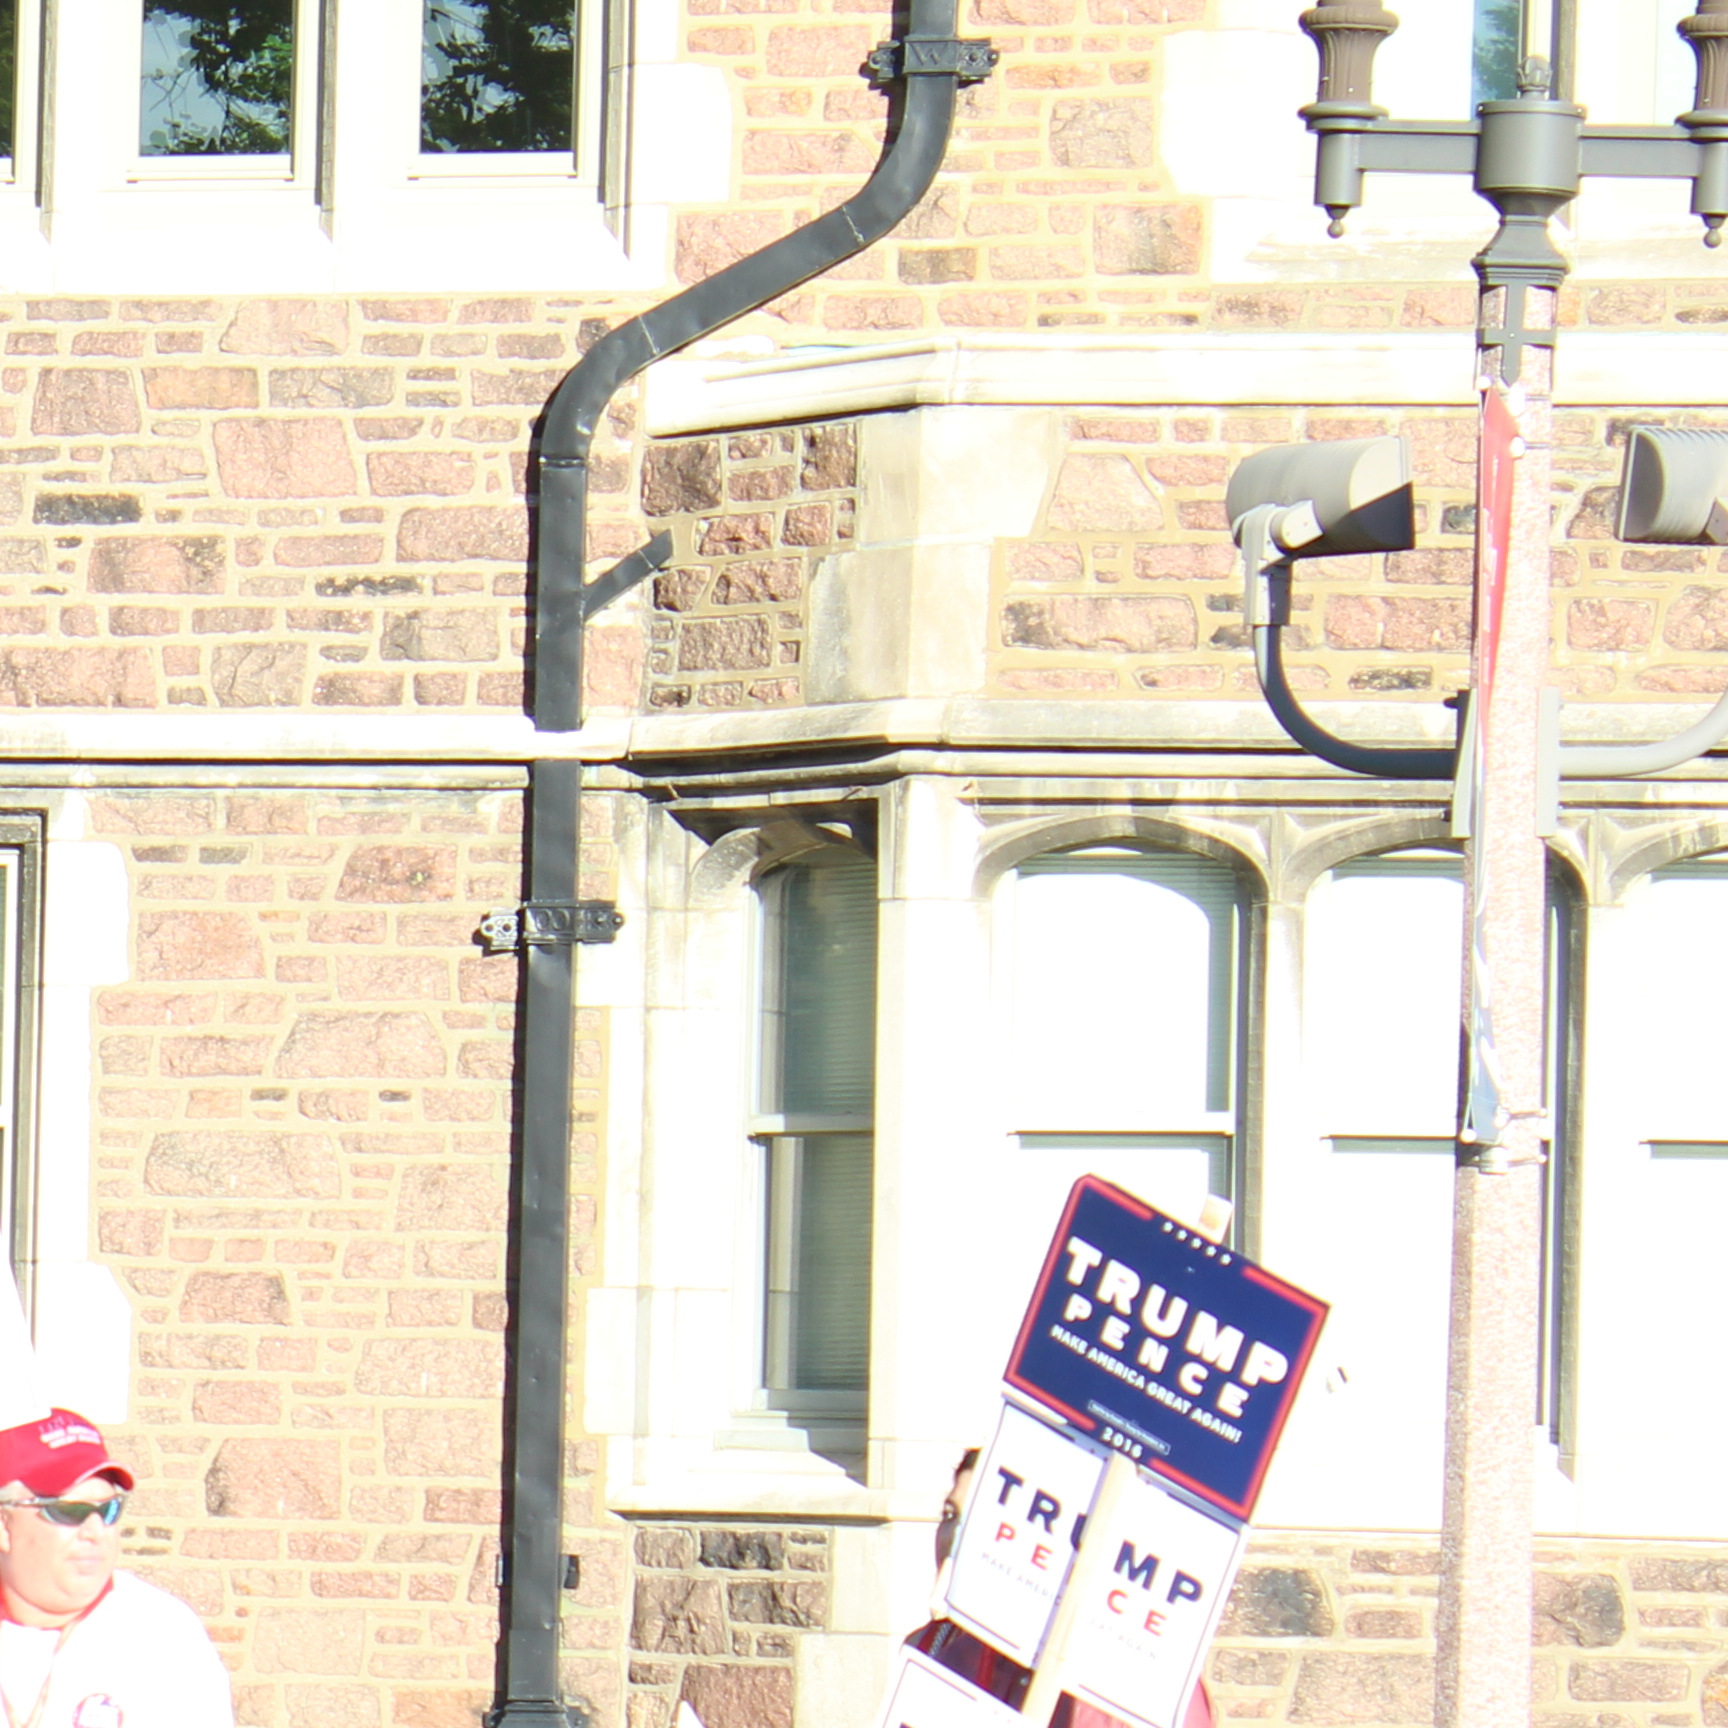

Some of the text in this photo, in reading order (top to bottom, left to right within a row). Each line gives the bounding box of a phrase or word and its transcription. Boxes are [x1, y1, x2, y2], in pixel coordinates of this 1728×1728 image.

[1063, 1292, 1250, 1419] PENCE
[1065, 1236, 1289, 1386] TRUMP
[1050, 1324, 1088, 1355] MAKE
[1087, 1348, 1145, 1390] AMERICA
[1146, 1381, 1192, 1415] GREAT
[1190, 1408, 1243, 1444] AGAIN!
[1100, 1427, 1143, 1458] 2016
[995, 1522, 1168, 1637] PECE
